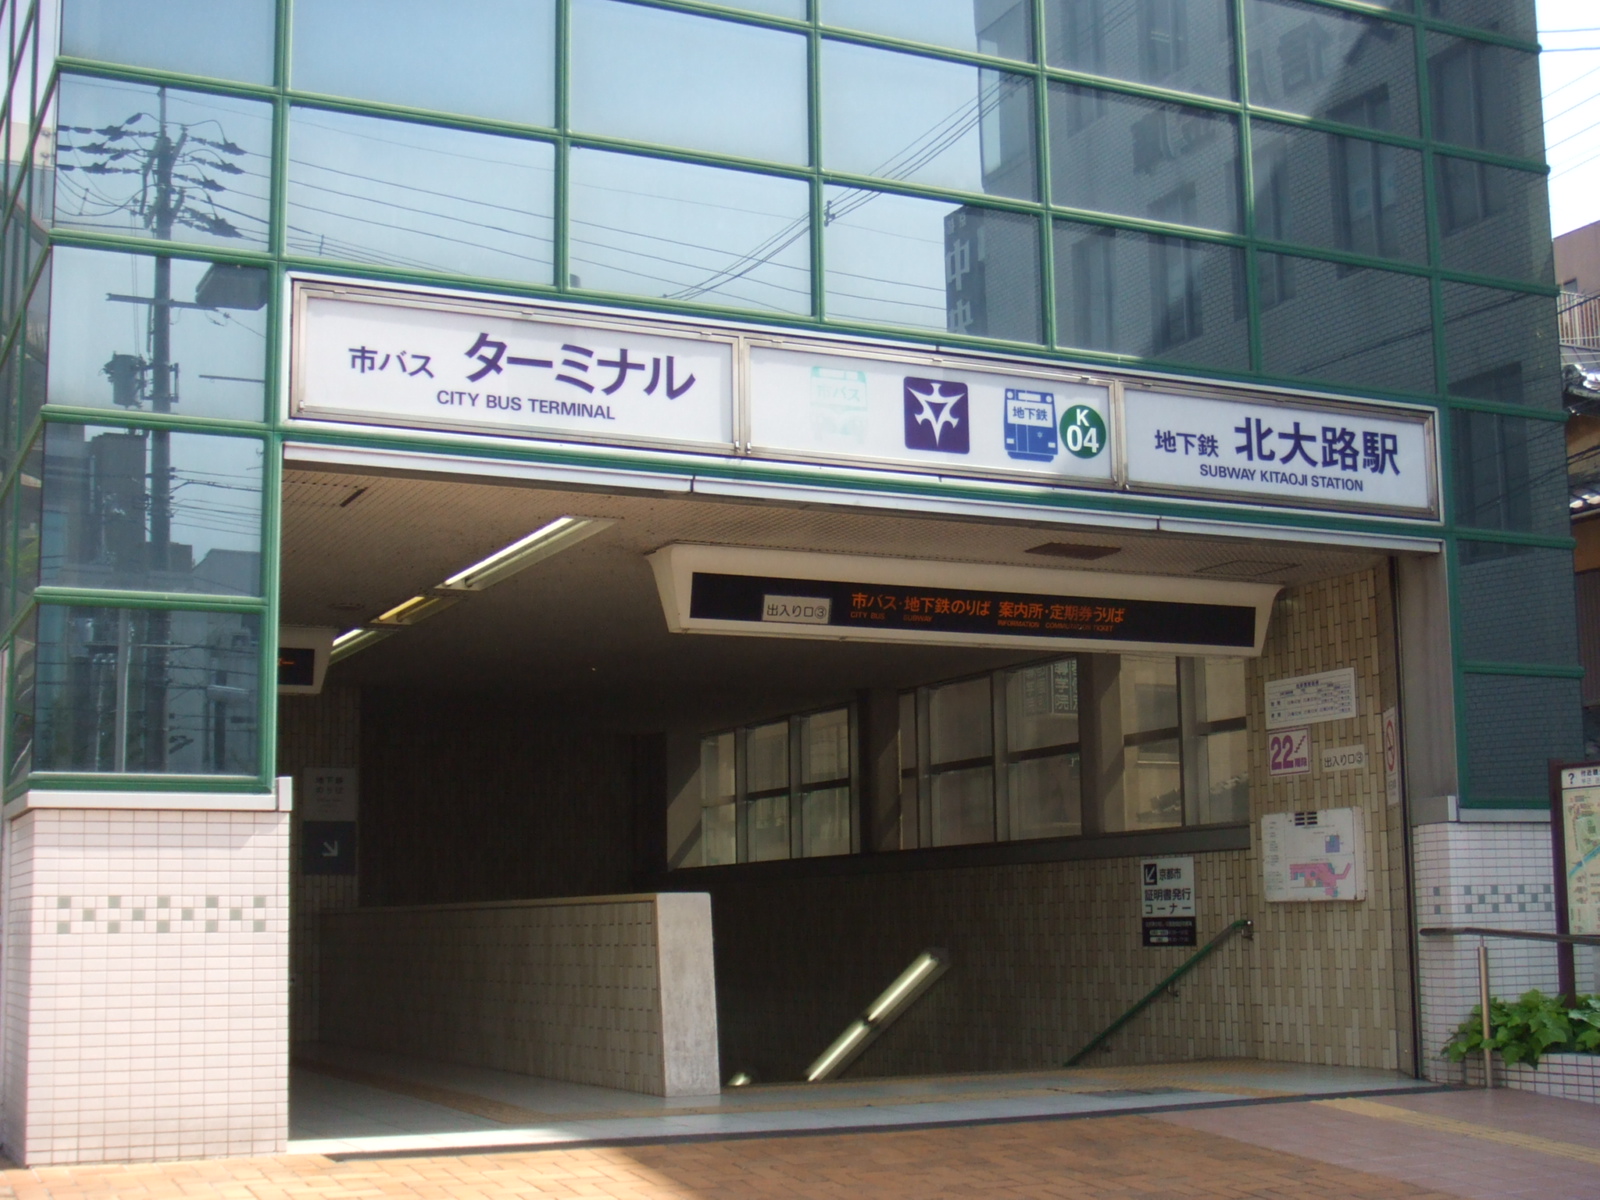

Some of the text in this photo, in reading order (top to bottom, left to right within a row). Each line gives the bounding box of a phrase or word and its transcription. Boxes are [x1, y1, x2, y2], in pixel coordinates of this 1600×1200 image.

[348, 332, 696, 400] 市バス ターミナル
[437, 390, 615, 421] CITY BUS TERMINAL
[1012, 406, 1048, 422] 地下鉄
[1076, 409, 1089, 427] K
[1066, 425, 1099, 453] 04
[1154, 417, 1400, 476] 地下鉄 北大路駅
[1200, 464, 1364, 492] SUBWAY KITAOJI STATION
[850, 611, 868, 619] CITY
[870, 612, 886, 620] BUS
[903, 614, 934, 622] SUBWAY
[997, 619, 1040, 628] INFORMATION
[1271, 734, 1294, 770] 22
[1145, 903, 1191, 914] コーナー
